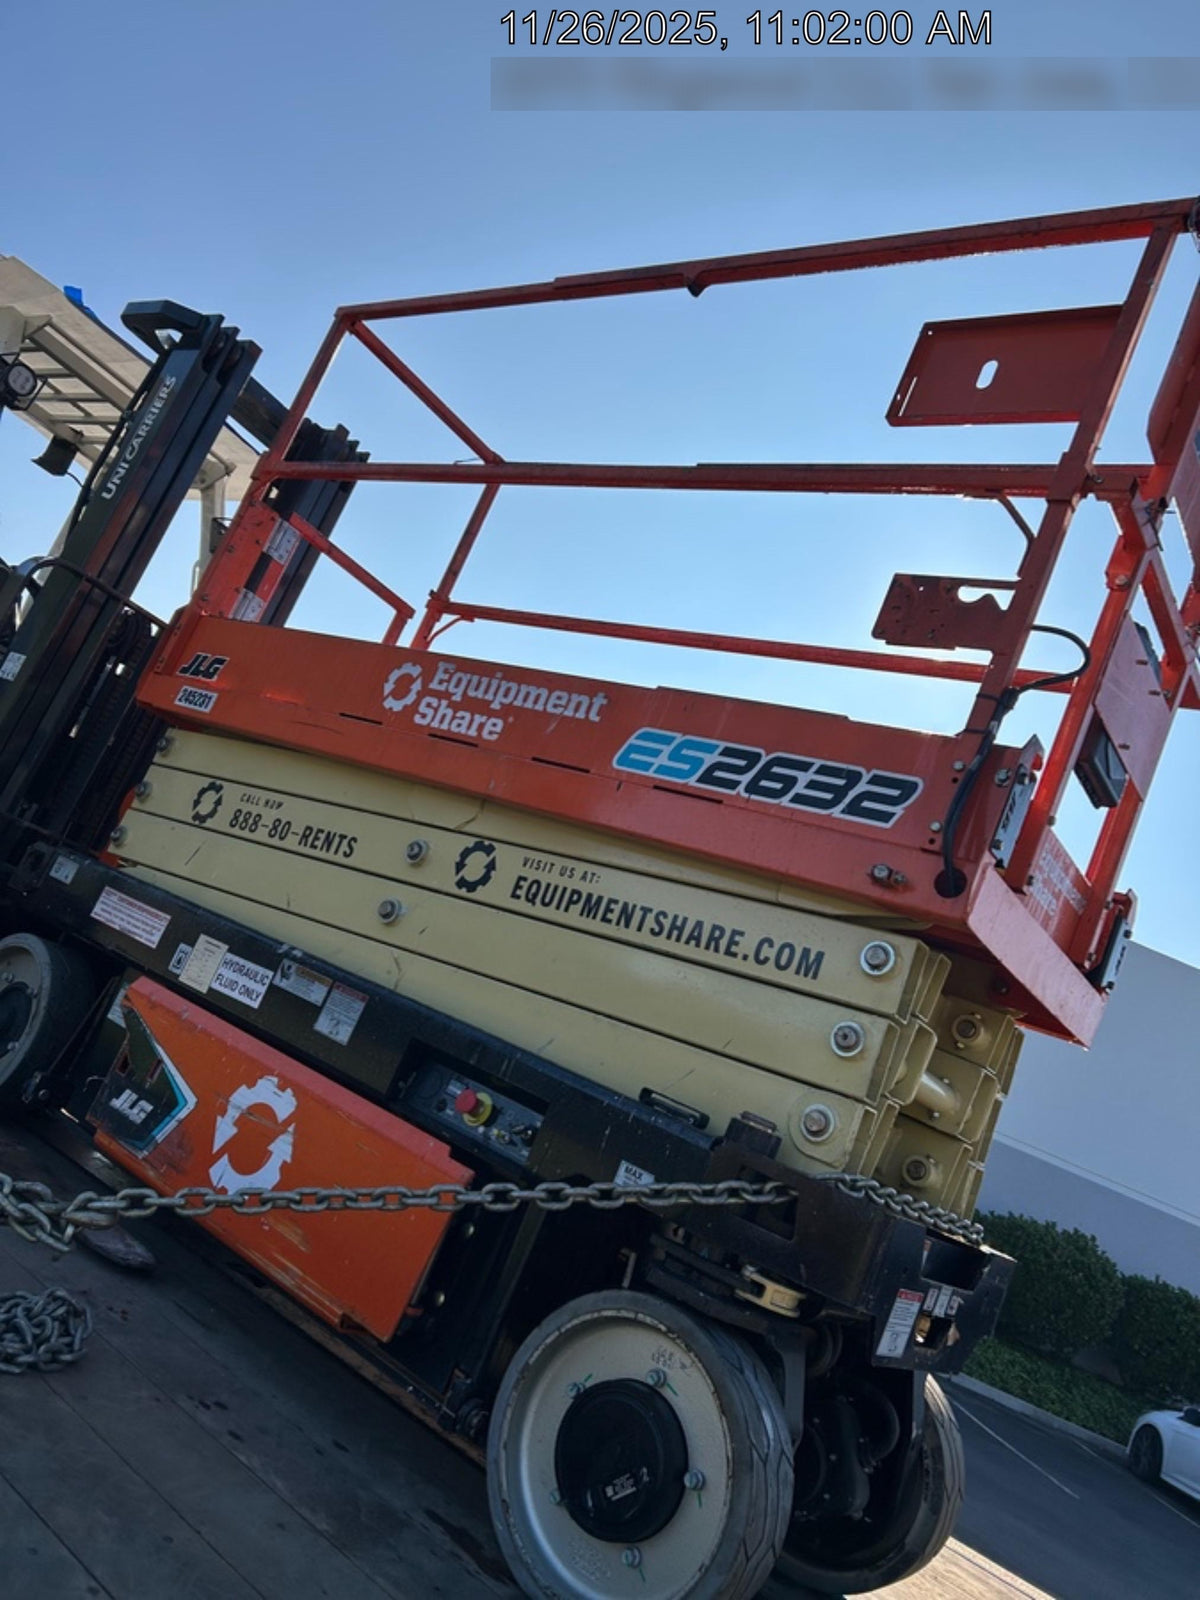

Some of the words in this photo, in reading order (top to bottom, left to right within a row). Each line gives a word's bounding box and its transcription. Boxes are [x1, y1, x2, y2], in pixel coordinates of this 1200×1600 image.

[101, 374, 176, 499] UNICARRIERS
[177, 653, 229, 681] JLG
[428, 661, 607, 722] Equipment
[413, 696, 504, 741] Share
[613, 728, 924, 828] ES2632
[240, 793, 261, 806] CALL
[264, 799, 284, 811] NOW
[229, 808, 358, 858] 888-80-RENTS
[522, 856, 555, 874] VISIT
[559, 866, 577, 880] US
[580, 870, 601, 884] AT:
[510, 875, 825, 981] EQUIPMENTSHARE.COM
[214, 974, 238, 992] FLUID
[237, 985, 262, 1002] ONLY
[221, 953, 270, 987] HYDRAULIC
[110, 1089, 154, 1124] JLG
